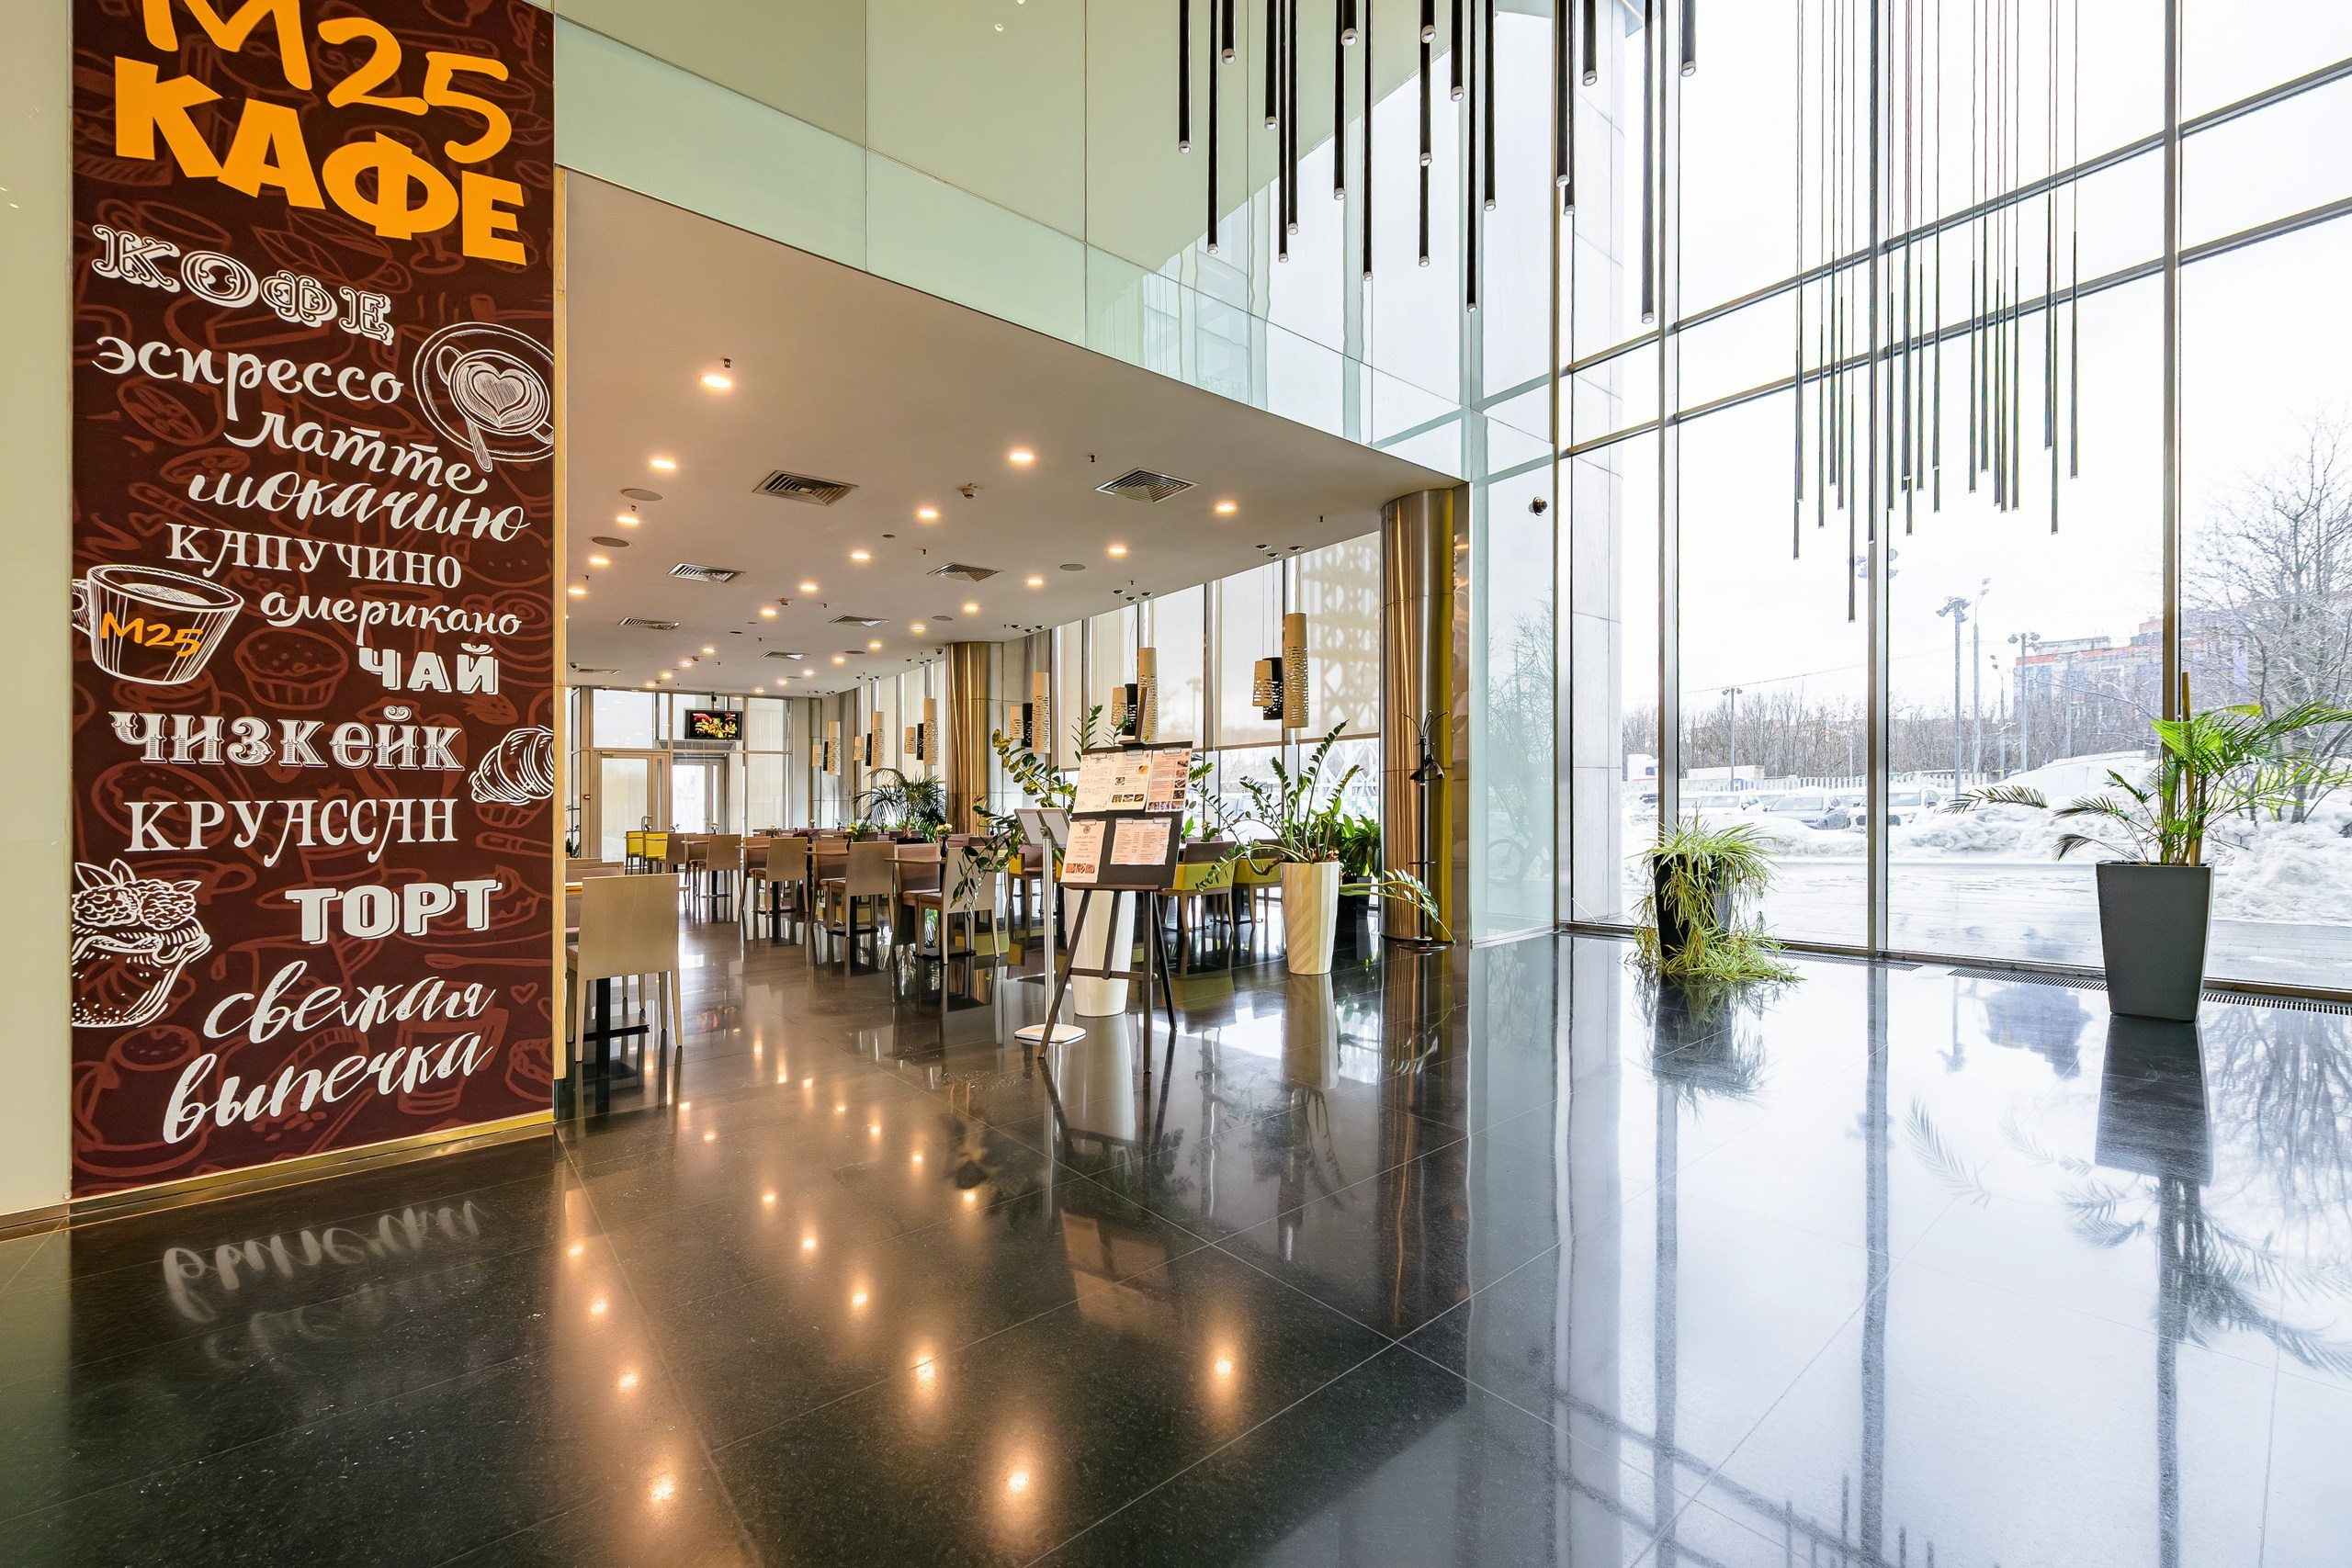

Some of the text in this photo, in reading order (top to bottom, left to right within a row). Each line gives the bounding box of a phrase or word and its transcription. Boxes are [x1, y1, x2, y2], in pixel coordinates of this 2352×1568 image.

[115, 56, 526, 265] КАФЕ
[92, 224, 395, 346] КОФЕ
[92, 336, 404, 422] эспрессо
[223, 412, 488, 495] латте
[187, 471, 531, 543] шокачино
[164, 523, 462, 590] КАПУЧИНО
[100, 613, 204, 658] М25
[260, 592, 523, 647] американо
[358, 642, 500, 695] ЧАЙ
[123, 797, 458, 868] КРУАССАН
[285, 879, 503, 945] ТОРТ
[202, 960, 496, 1044] свежая
[162, 1032, 494, 1145] выпечка
